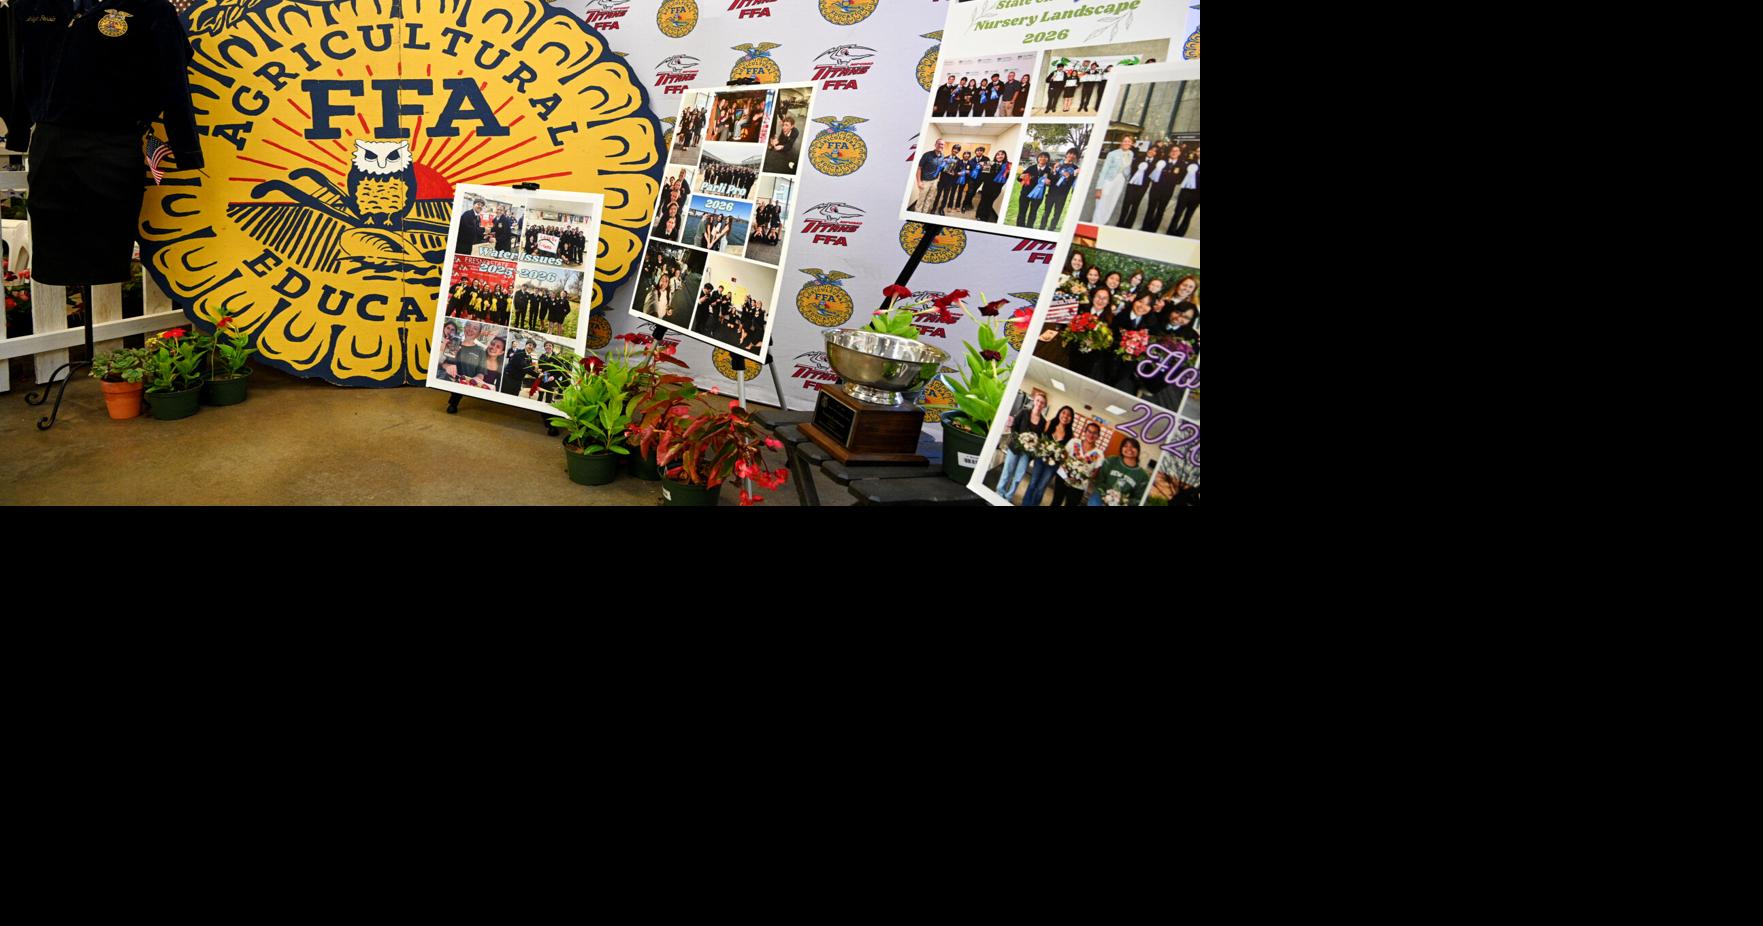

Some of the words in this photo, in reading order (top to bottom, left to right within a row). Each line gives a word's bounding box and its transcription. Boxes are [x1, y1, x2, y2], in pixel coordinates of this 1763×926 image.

[739, 7, 771, 19] FFA
[974, 15, 1039, 31] Nursery
[1041, 0, 1141, 23] Landscape
[594, 21, 620, 31] FFA
[1022, 29, 1070, 44] 2026
[746, 67, 765, 75] FFA
[212, 23, 578, 151] AGRICULTURAL
[822, 80, 858, 91] FFA
[301, 77, 510, 140] FFA
[701, 181, 727, 195] Parli
[727, 184, 747, 197] Pro
[704, 199, 735, 212] 2026
[812, 234, 847, 247] FFA
[479, 246, 518, 262] Water
[519, 252, 563, 267] Issues
[1027, 252, 1053, 265] FF
[243, 248, 440, 322] EDUCA
[815, 293, 836, 303] FFA
[909, 323, 946, 338] FA
[791, 364, 839, 382] TITAN
